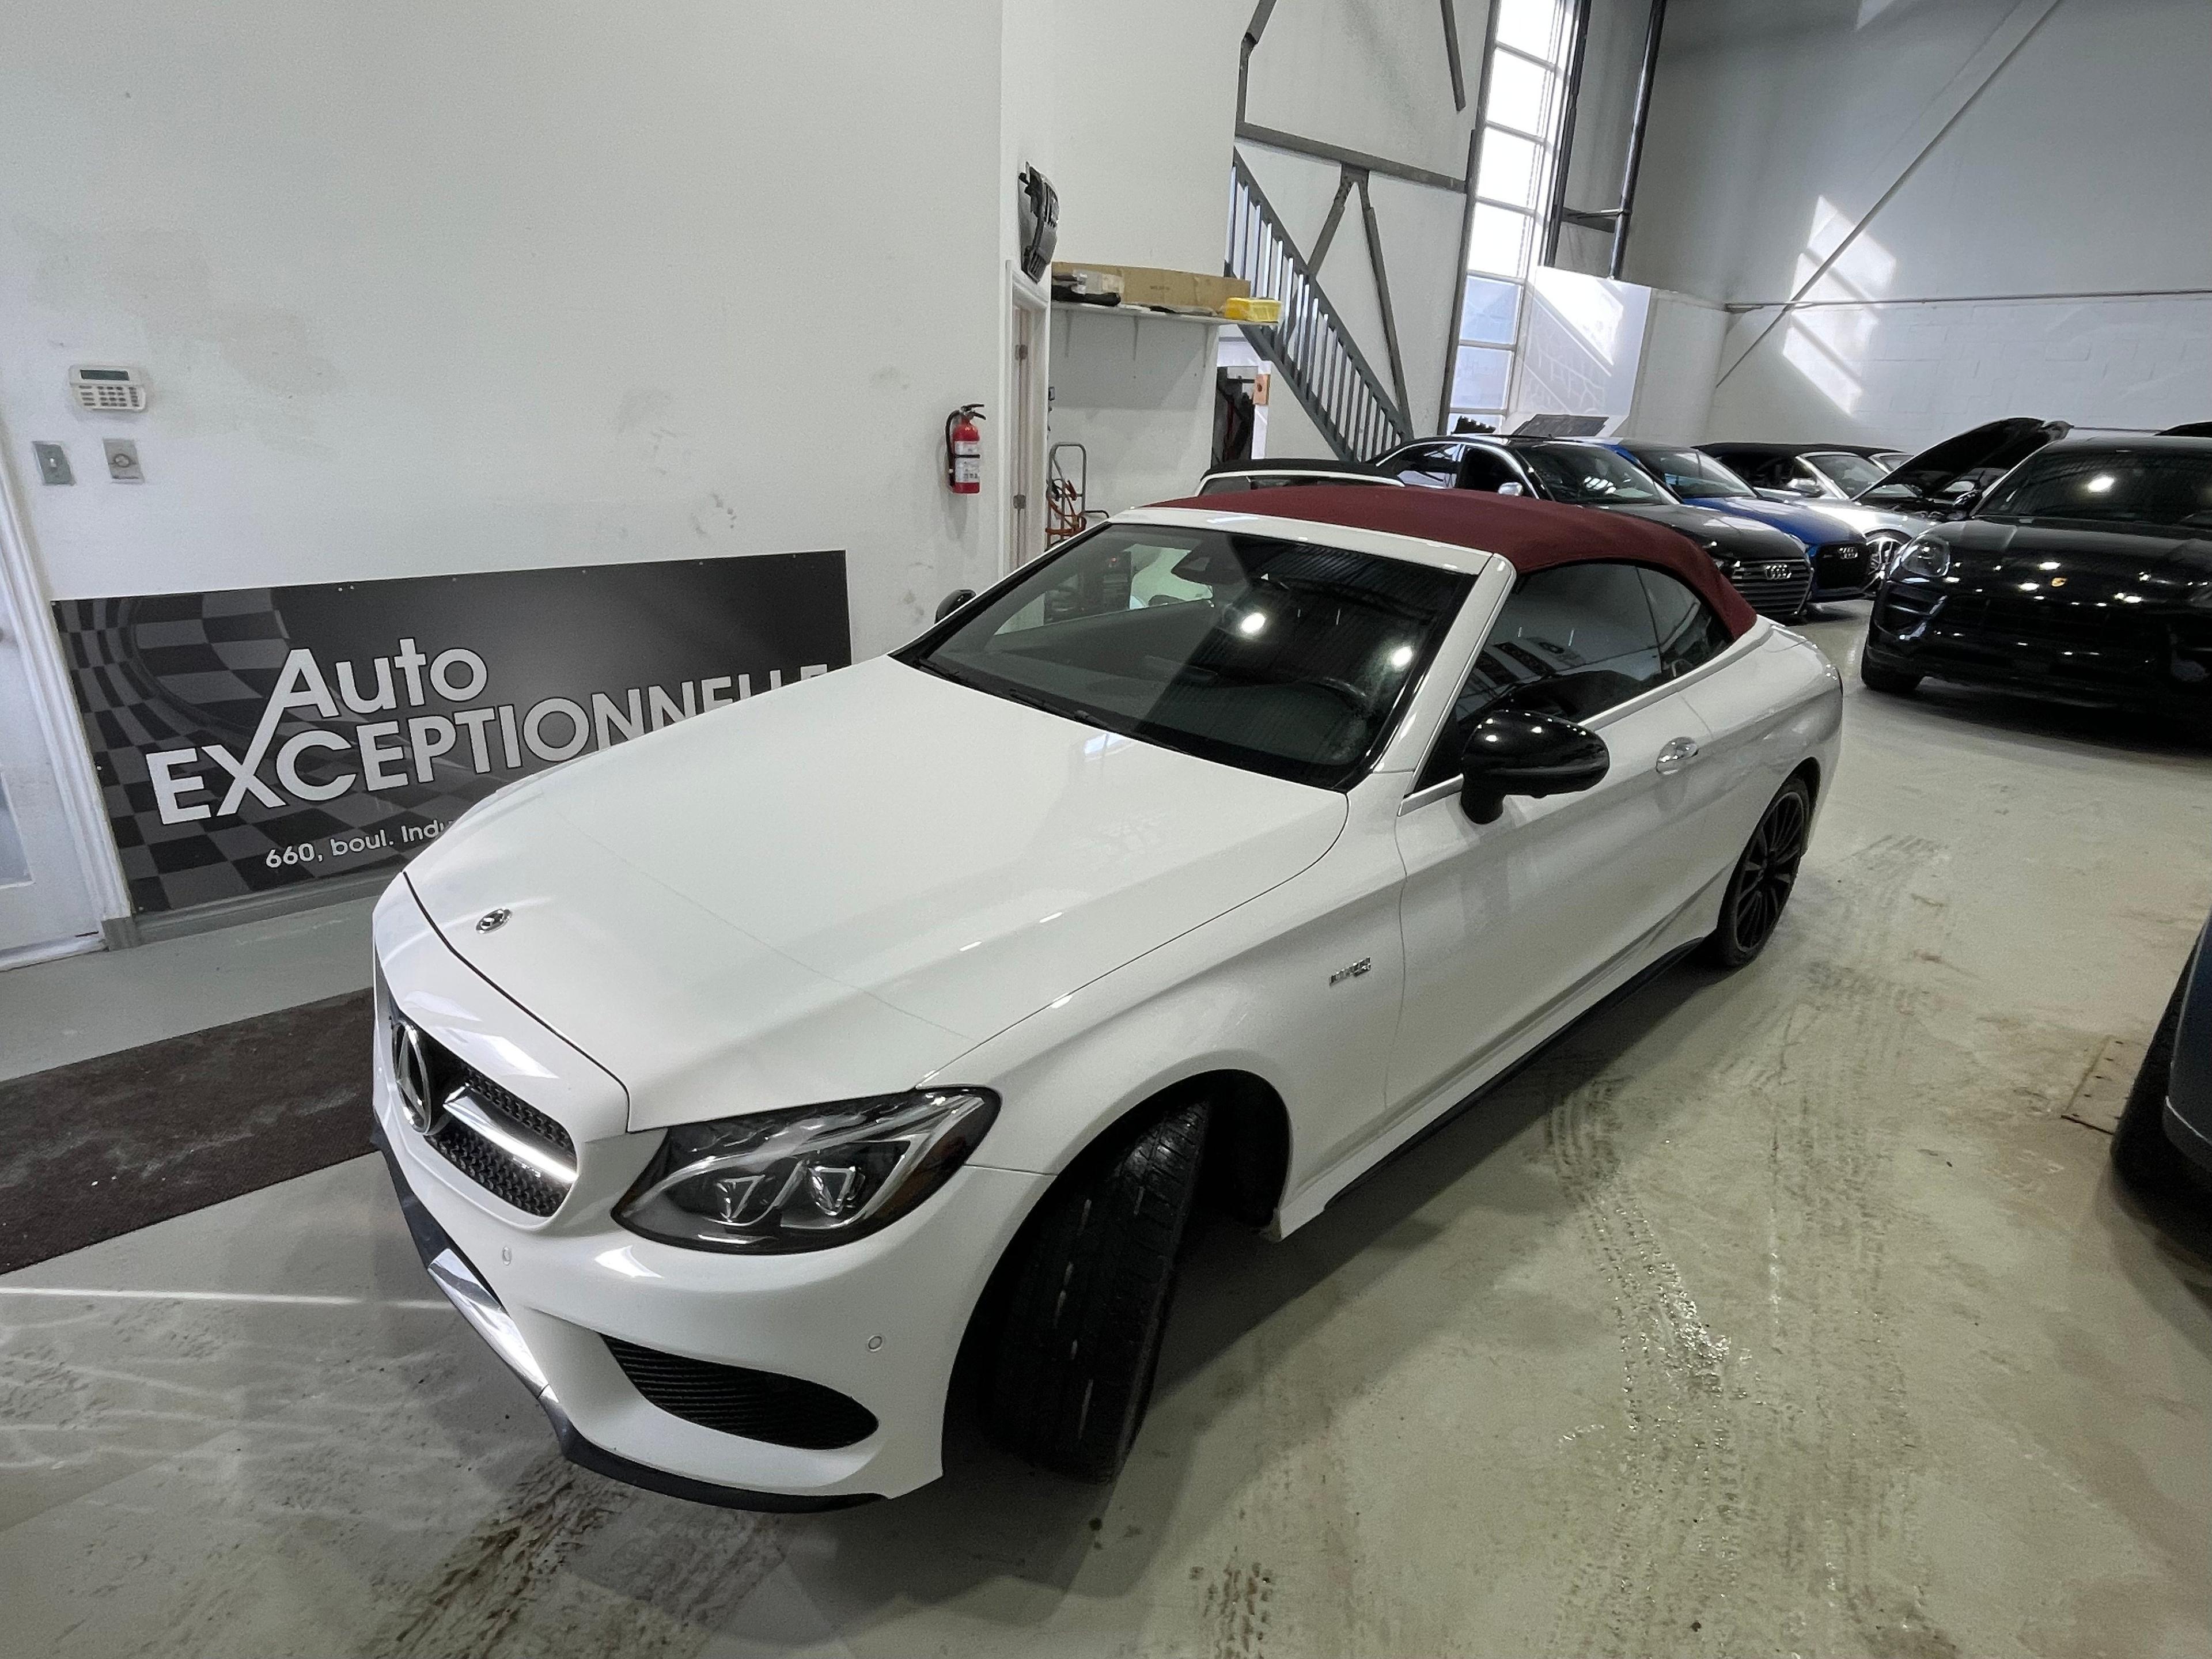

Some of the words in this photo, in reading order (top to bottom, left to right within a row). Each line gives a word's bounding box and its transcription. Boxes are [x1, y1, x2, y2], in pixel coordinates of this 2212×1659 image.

[259, 638, 488, 719] Auto
[145, 663, 828, 825] EXCEPTIONNE
[265, 842, 323, 869] 660,
[329, 829, 394, 857] boul.
